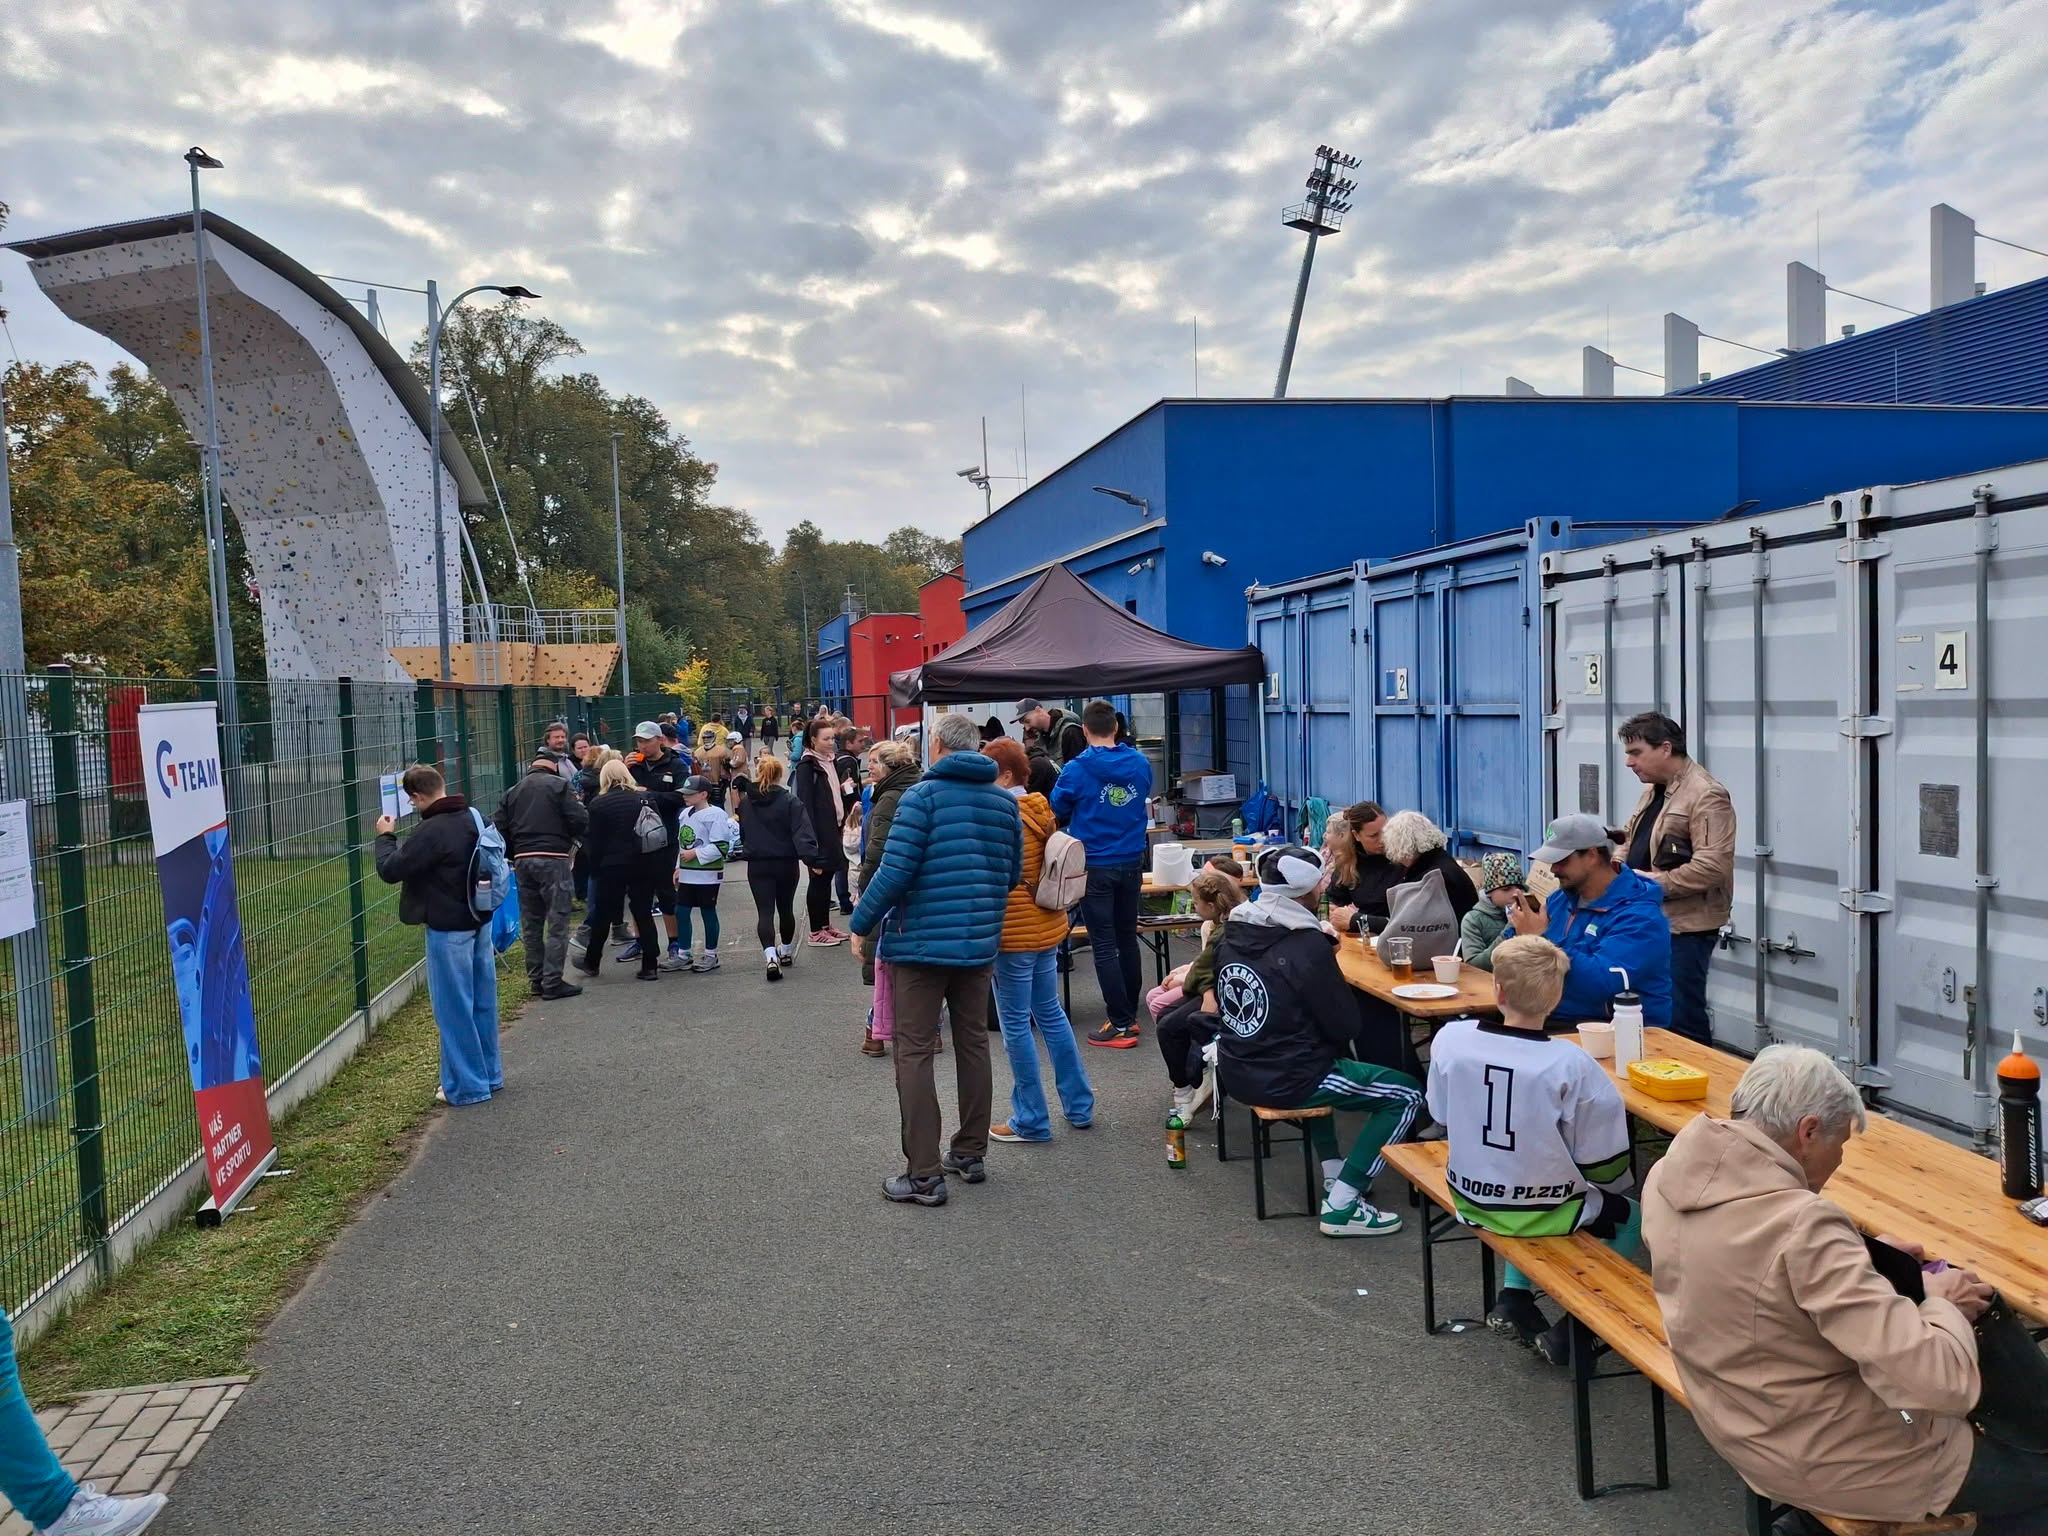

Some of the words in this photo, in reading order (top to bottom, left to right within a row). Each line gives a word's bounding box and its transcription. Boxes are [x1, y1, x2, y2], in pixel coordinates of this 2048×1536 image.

[1589, 662, 1598, 684] 3
[1939, 643, 1958, 675] 4
[1399, 674, 1405, 692] 2
[178, 757, 218, 793] TEAM
[1400, 923, 1450, 933] VAUGHN
[1221, 966, 1259, 990] LAKROS
[1482, 1064, 1516, 1152] 1
[208, 1110, 223, 1139] VÁŠ
[212, 1122, 243, 1164] PARTNER
[2027, 1106, 2038, 1190] WINNWELL
[215, 1165, 227, 1188] VE
[224, 1139, 252, 1178] SPORTU
[1461, 1175, 1506, 1199] DOGS
